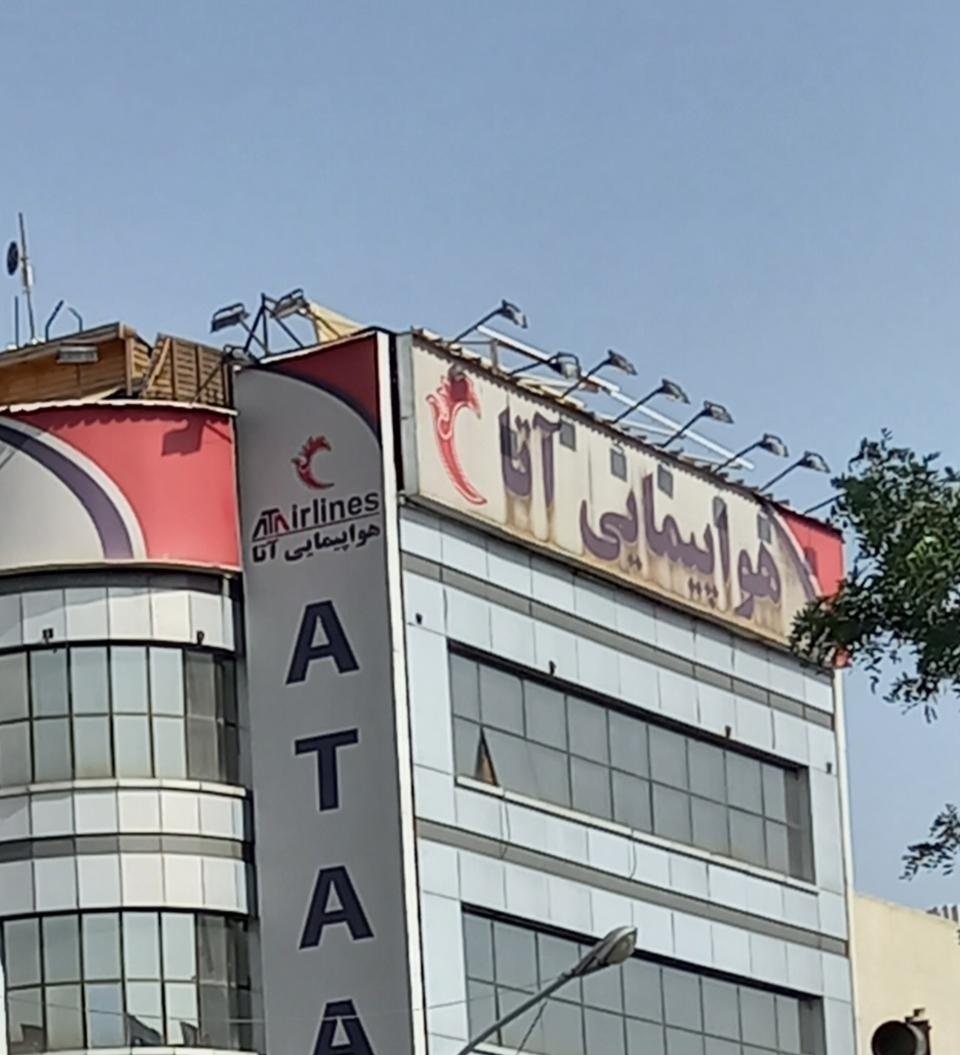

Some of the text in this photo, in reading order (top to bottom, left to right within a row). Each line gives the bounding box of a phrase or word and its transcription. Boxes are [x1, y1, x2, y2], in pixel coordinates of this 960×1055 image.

[252, 523, 381, 563] هواپیمایی آتا
[498, 406, 782, 620] هواپیمایی آتا
